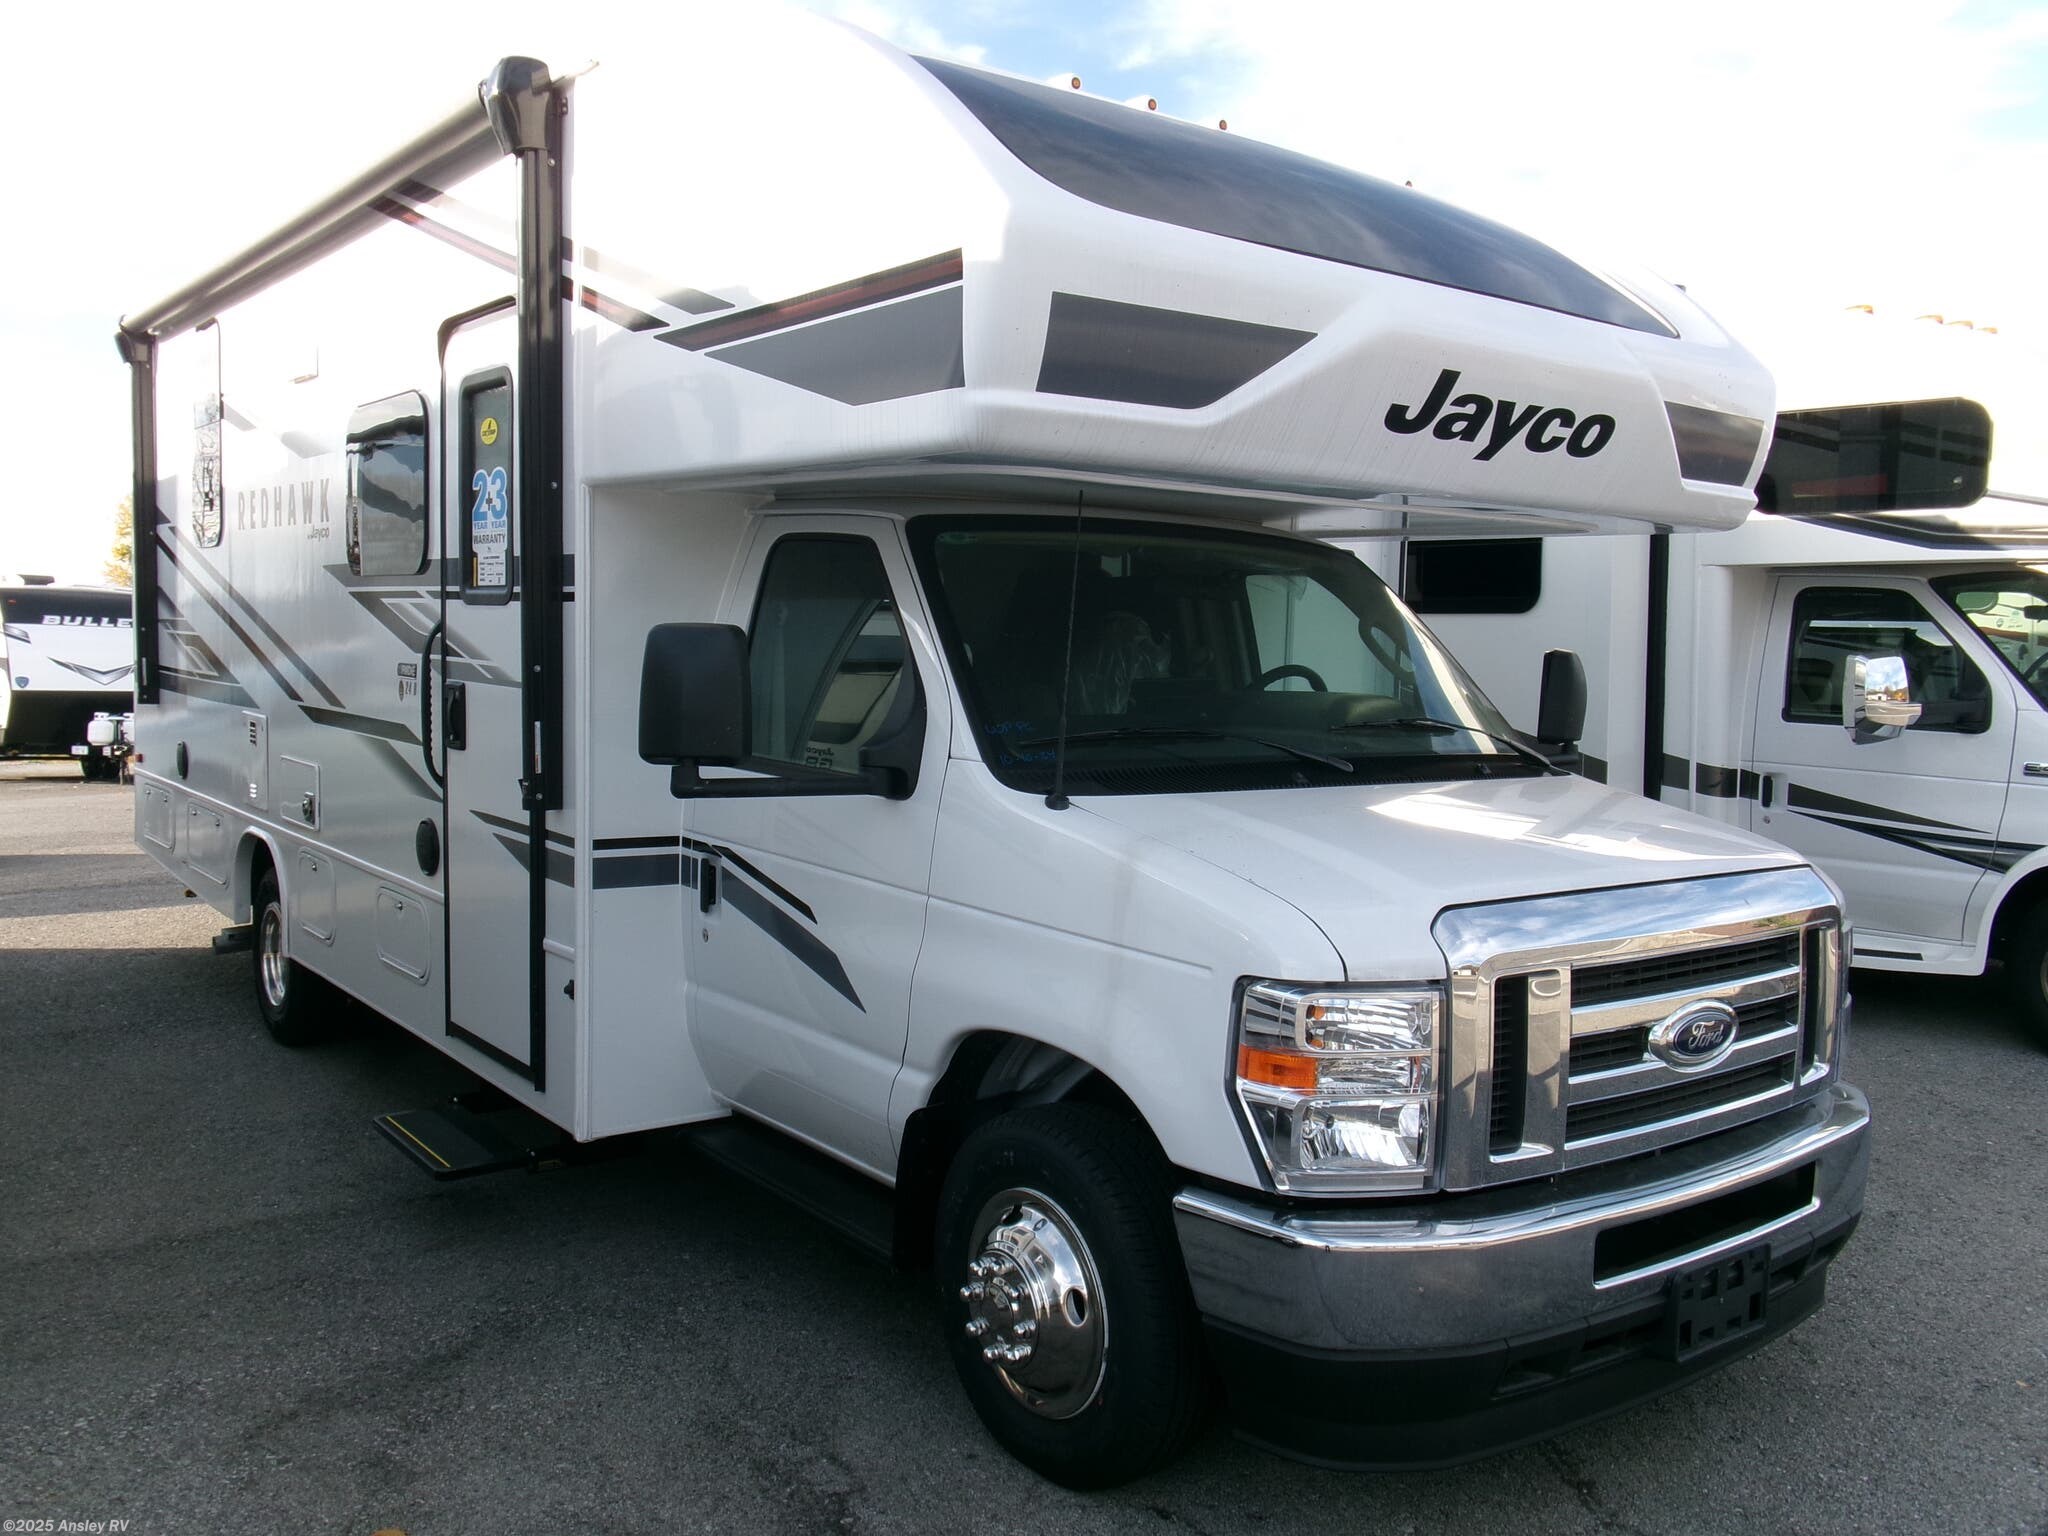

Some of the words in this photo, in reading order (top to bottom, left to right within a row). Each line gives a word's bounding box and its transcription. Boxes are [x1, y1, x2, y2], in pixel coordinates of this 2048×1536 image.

[1384, 368, 1617, 461] Jayco
[237, 478, 330, 531] REDHAWK
[473, 521, 489, 530] YEAR
[491, 520, 506, 530] YEAR
[473, 533, 506, 545] WARRANTY
[1688, 1020, 1724, 1049] Ford
